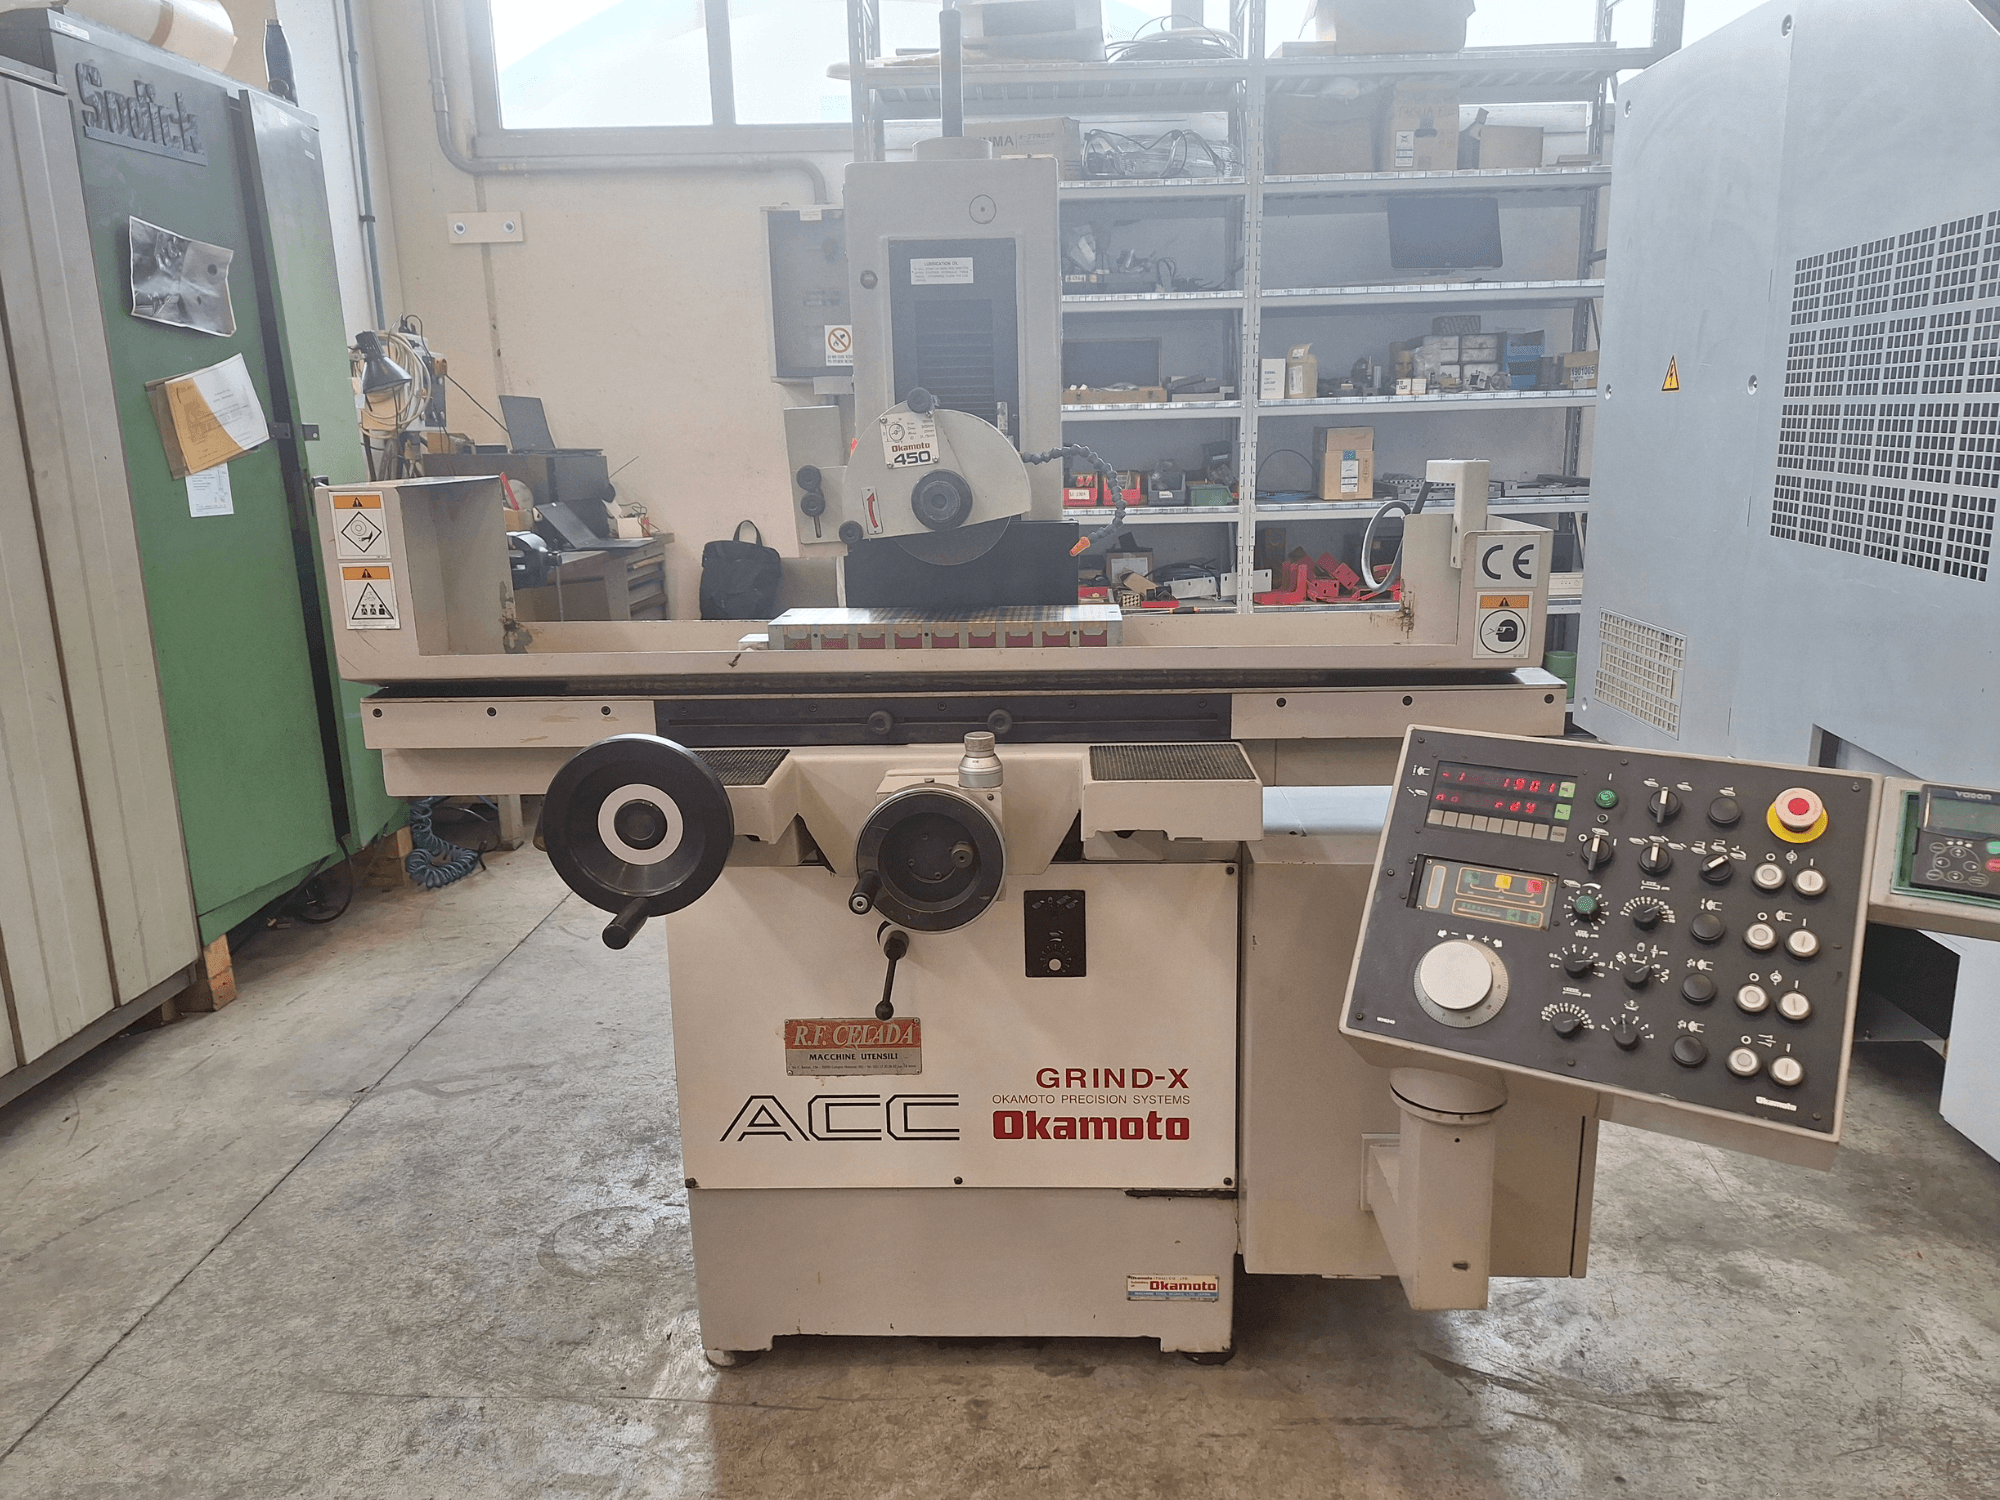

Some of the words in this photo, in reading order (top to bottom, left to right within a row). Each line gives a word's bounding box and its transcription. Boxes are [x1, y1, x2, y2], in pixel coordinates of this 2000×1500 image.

[76, 63, 205, 154] Sodick
[891, 442, 931, 453] Okamoto
[894, 450, 931, 465] 450
[1481, 544, 1535, 580] CE
[832, 1022, 914, 1046] CELADA
[809, 1053, 856, 1061] MACCHINE
[861, 1052, 898, 1060] UTENSILI
[1036, 1068, 1189, 1089] GRIND-X
[992, 1095, 1055, 1104] OKAMOTO
[1061, 1095, 1127, 1104] PRECISION
[1132, 1095, 1190, 1105] SYSTEMS
[719, 1094, 960, 1141] ACC
[992, 1110, 1190, 1140] Okamoto
[1149, 1281, 1216, 1291] Okamoto
